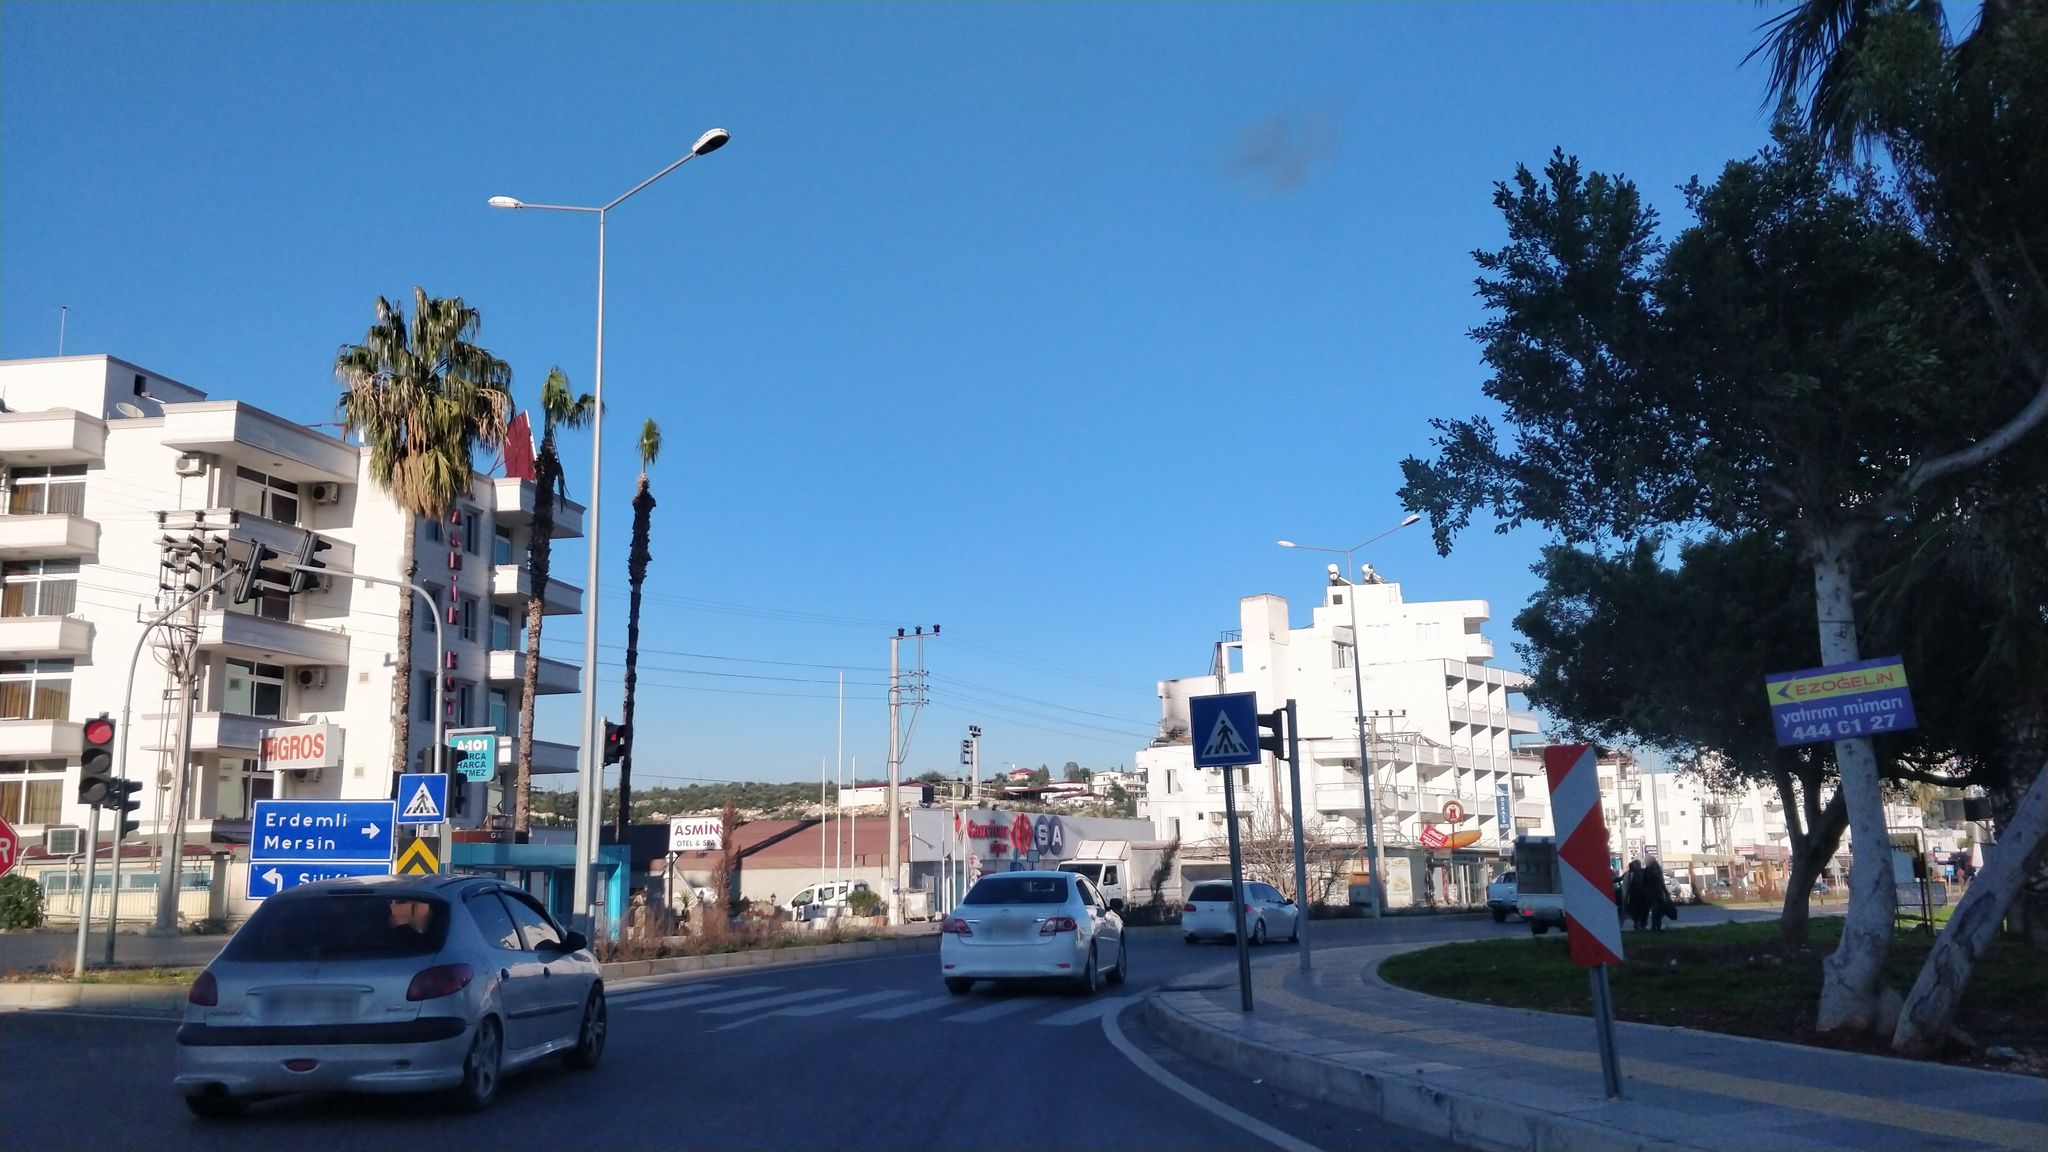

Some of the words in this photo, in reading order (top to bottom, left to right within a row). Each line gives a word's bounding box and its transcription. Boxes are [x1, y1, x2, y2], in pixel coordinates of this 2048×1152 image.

[1792, 723, 1832, 740] 444
[1870, 714, 1896, 730] 27
[265, 812, 347, 827] Erdemli
[263, 835, 336, 850] Mersin
